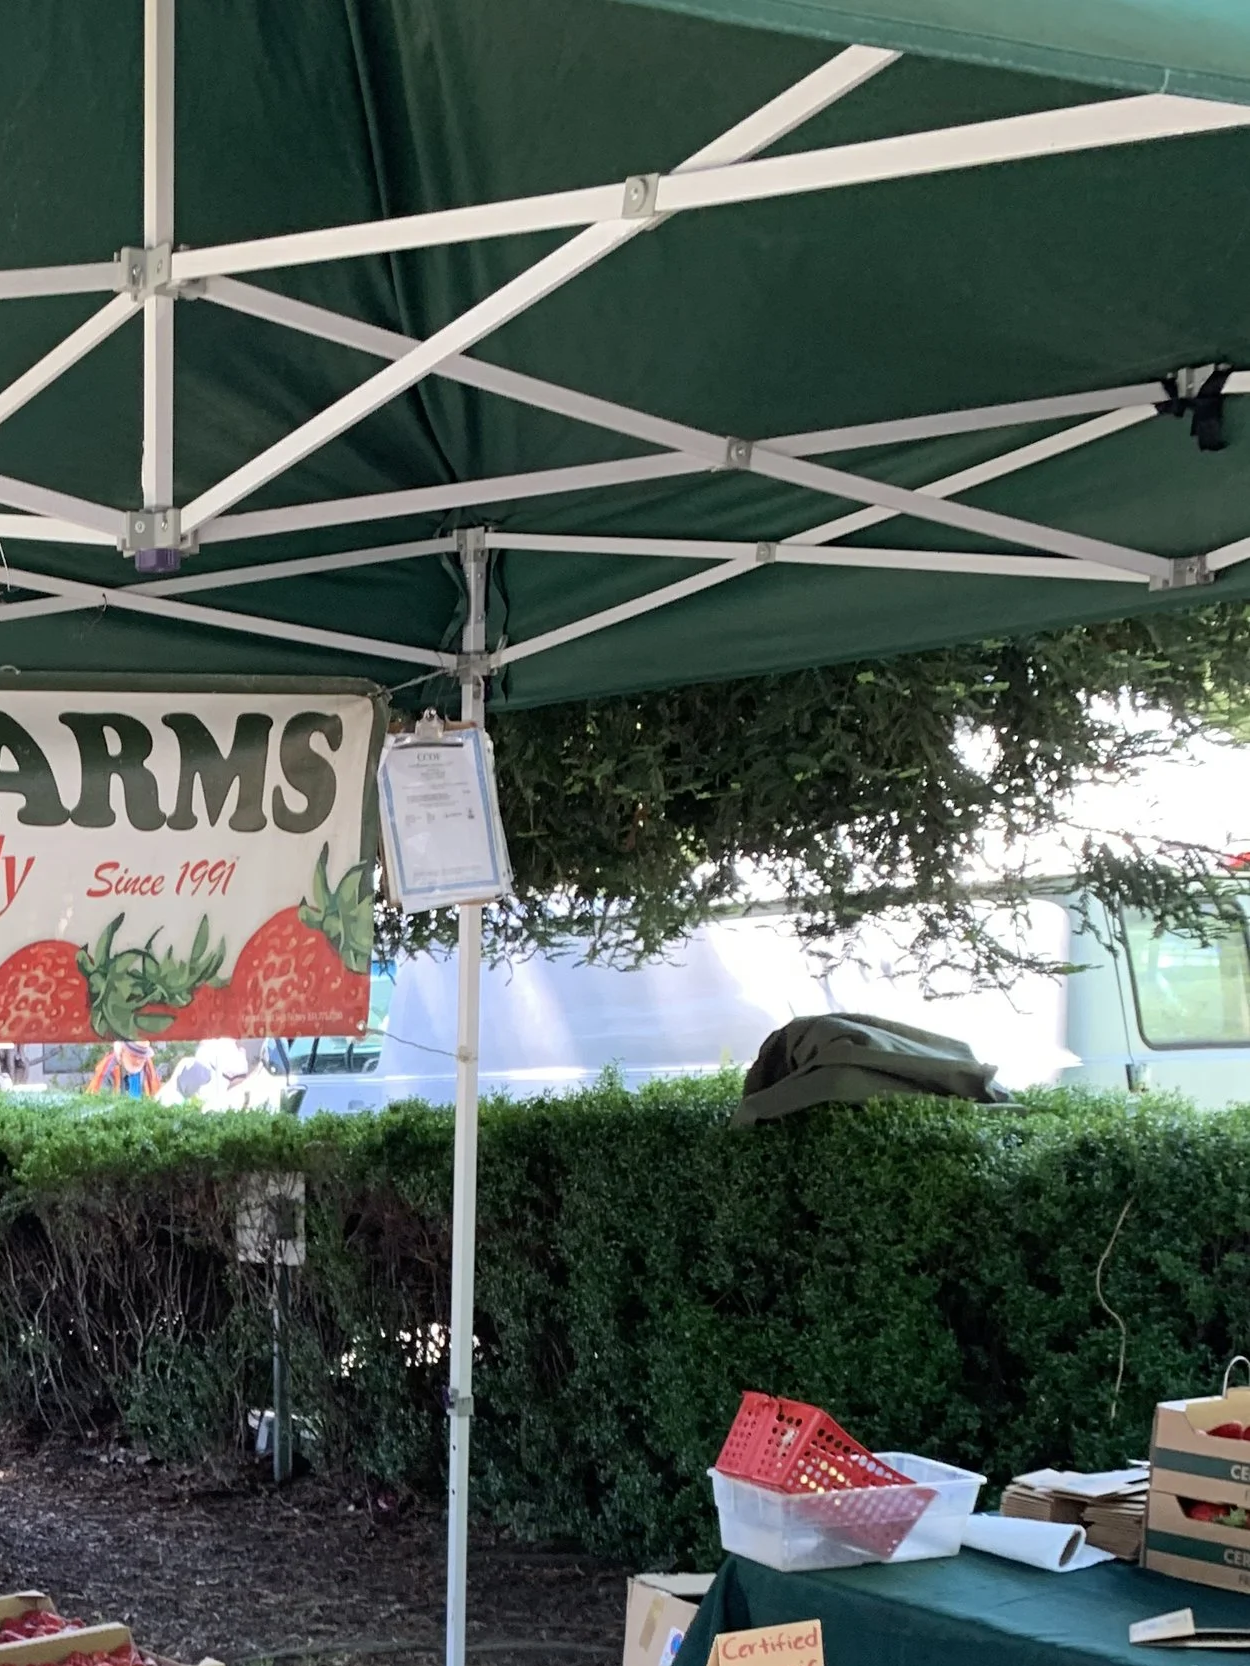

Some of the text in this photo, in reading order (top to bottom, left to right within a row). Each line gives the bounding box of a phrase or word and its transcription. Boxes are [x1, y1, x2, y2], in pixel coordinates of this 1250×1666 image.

[86, 859, 237, 898] Since 1991
[722, 1627, 819, 1660] Certified
